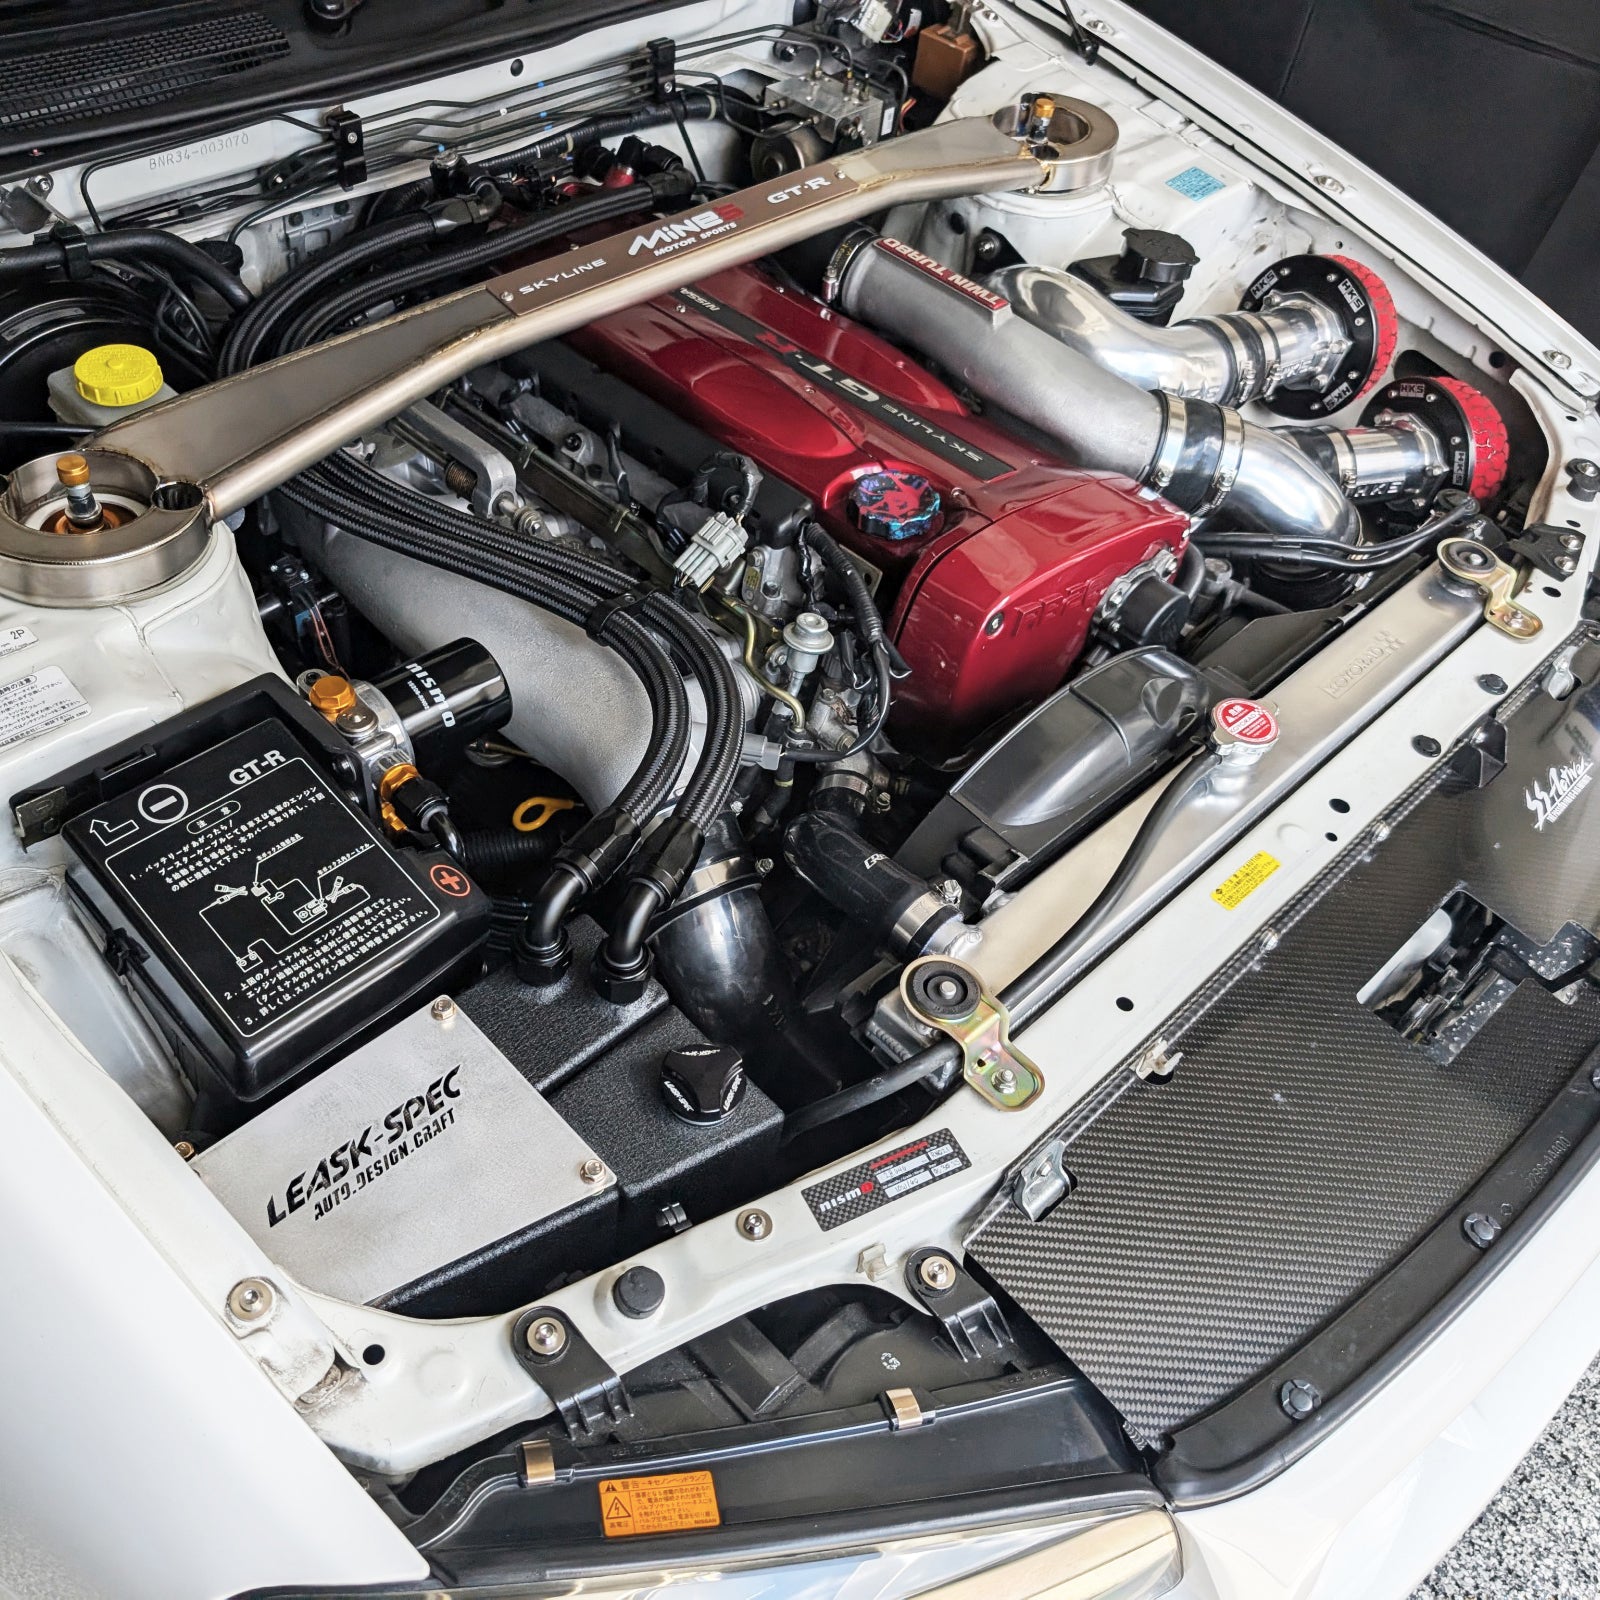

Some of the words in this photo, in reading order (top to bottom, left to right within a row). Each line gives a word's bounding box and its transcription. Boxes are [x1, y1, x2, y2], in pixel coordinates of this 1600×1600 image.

[149, 131, 249, 170] BNR34-003070
[654, 237, 697, 257] MOTOR
[700, 221, 737, 240] SPORTS
[883, 237, 948, 276] TURBO
[518, 258, 607, 295] SKYLINE
[948, 274, 1001, 305] TWIN
[1251, 271, 1276, 297] HKS
[1341, 280, 1363, 310] HKS
[1325, 385, 1351, 409] HKS
[1400, 383, 1425, 396] HKS
[881, 403, 983, 462] SKYLINE
[1353, 481, 1402, 498] HKS
[10, 629, 25, 640] 2P
[405, 662, 456, 728] nismo
[229, 750, 286, 785] GT-R
[267, 1064, 461, 1228] LEASK-SPEC
[314, 1107, 455, 1221] AUTO.DESIGN.CRAFT
[820, 1181, 875, 1212] nismo
